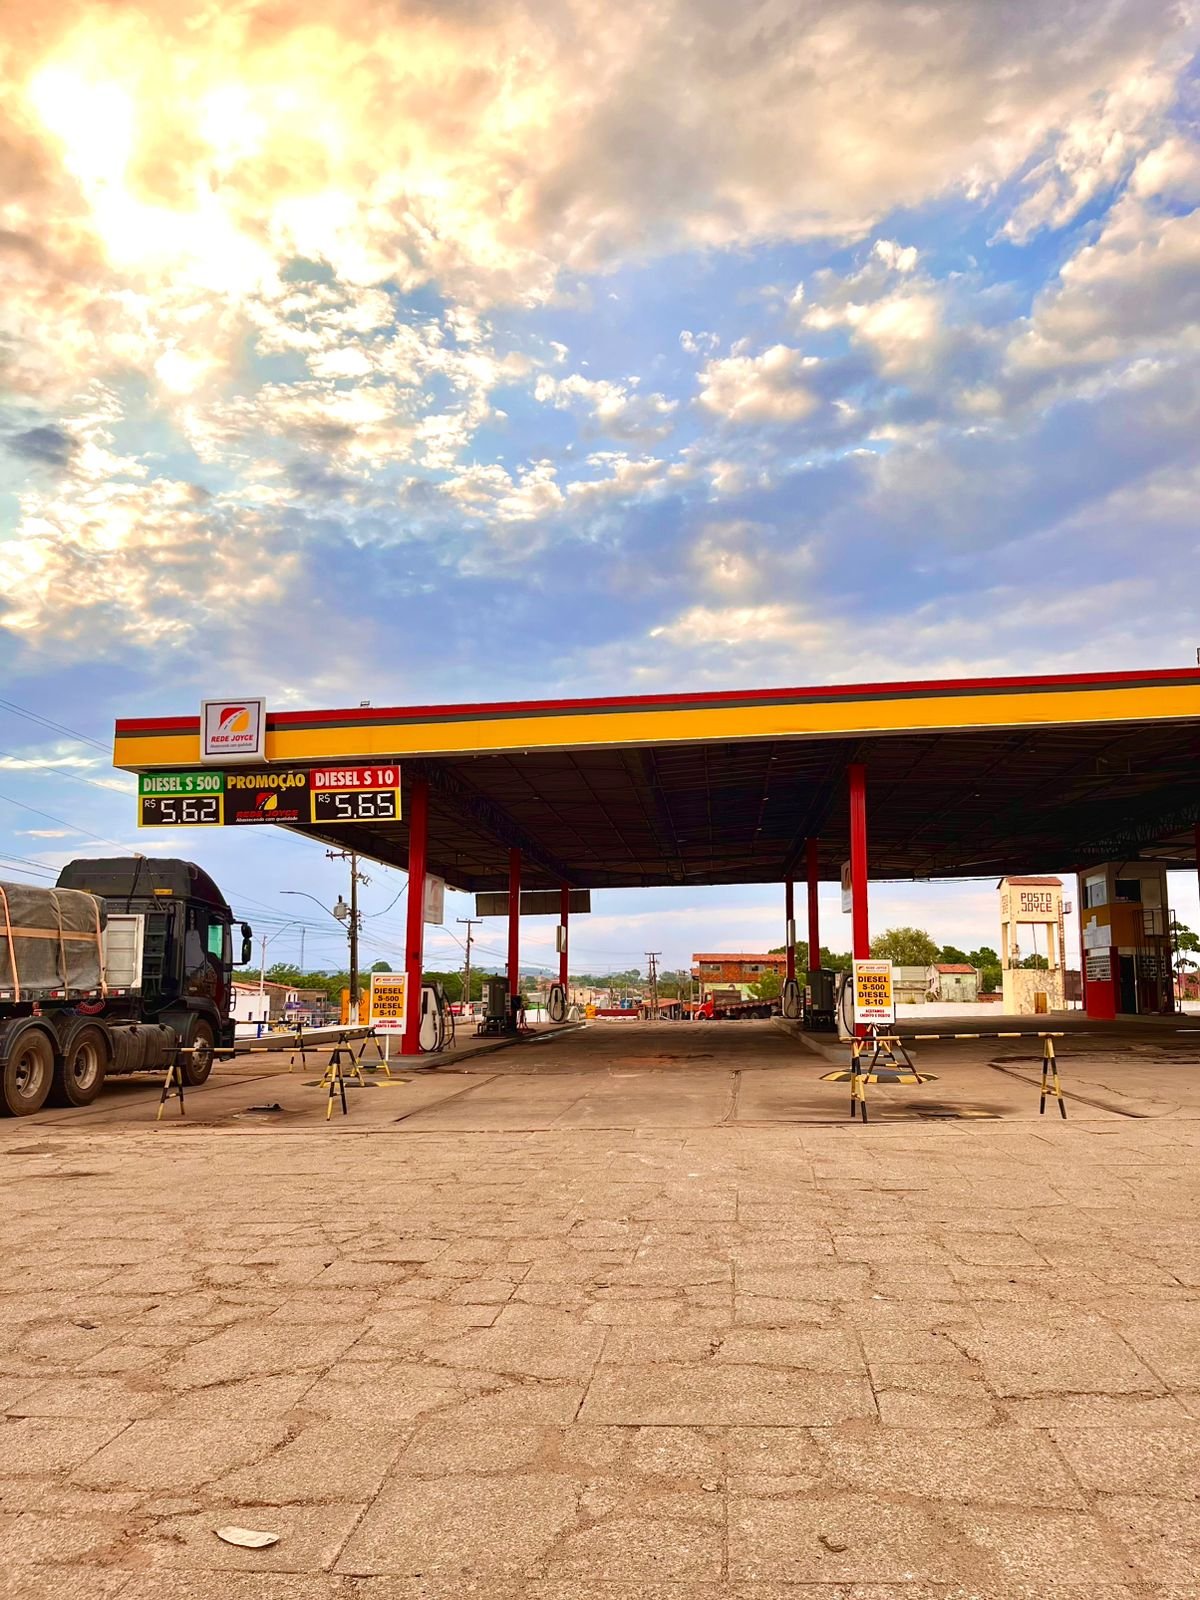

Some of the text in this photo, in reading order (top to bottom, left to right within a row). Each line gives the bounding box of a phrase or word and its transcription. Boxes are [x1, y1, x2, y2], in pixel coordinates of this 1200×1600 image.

[228, 770, 306, 791] PROMOÇÃO
[316, 770, 394, 786] DIESEL S 10
[144, 776, 220, 792] DIESEL S 500
[318, 794, 330, 803] R$
[144, 799, 156, 808] R$
[1020, 893, 1052, 902] POSTO
[1022, 903, 1052, 912] JOYCE
